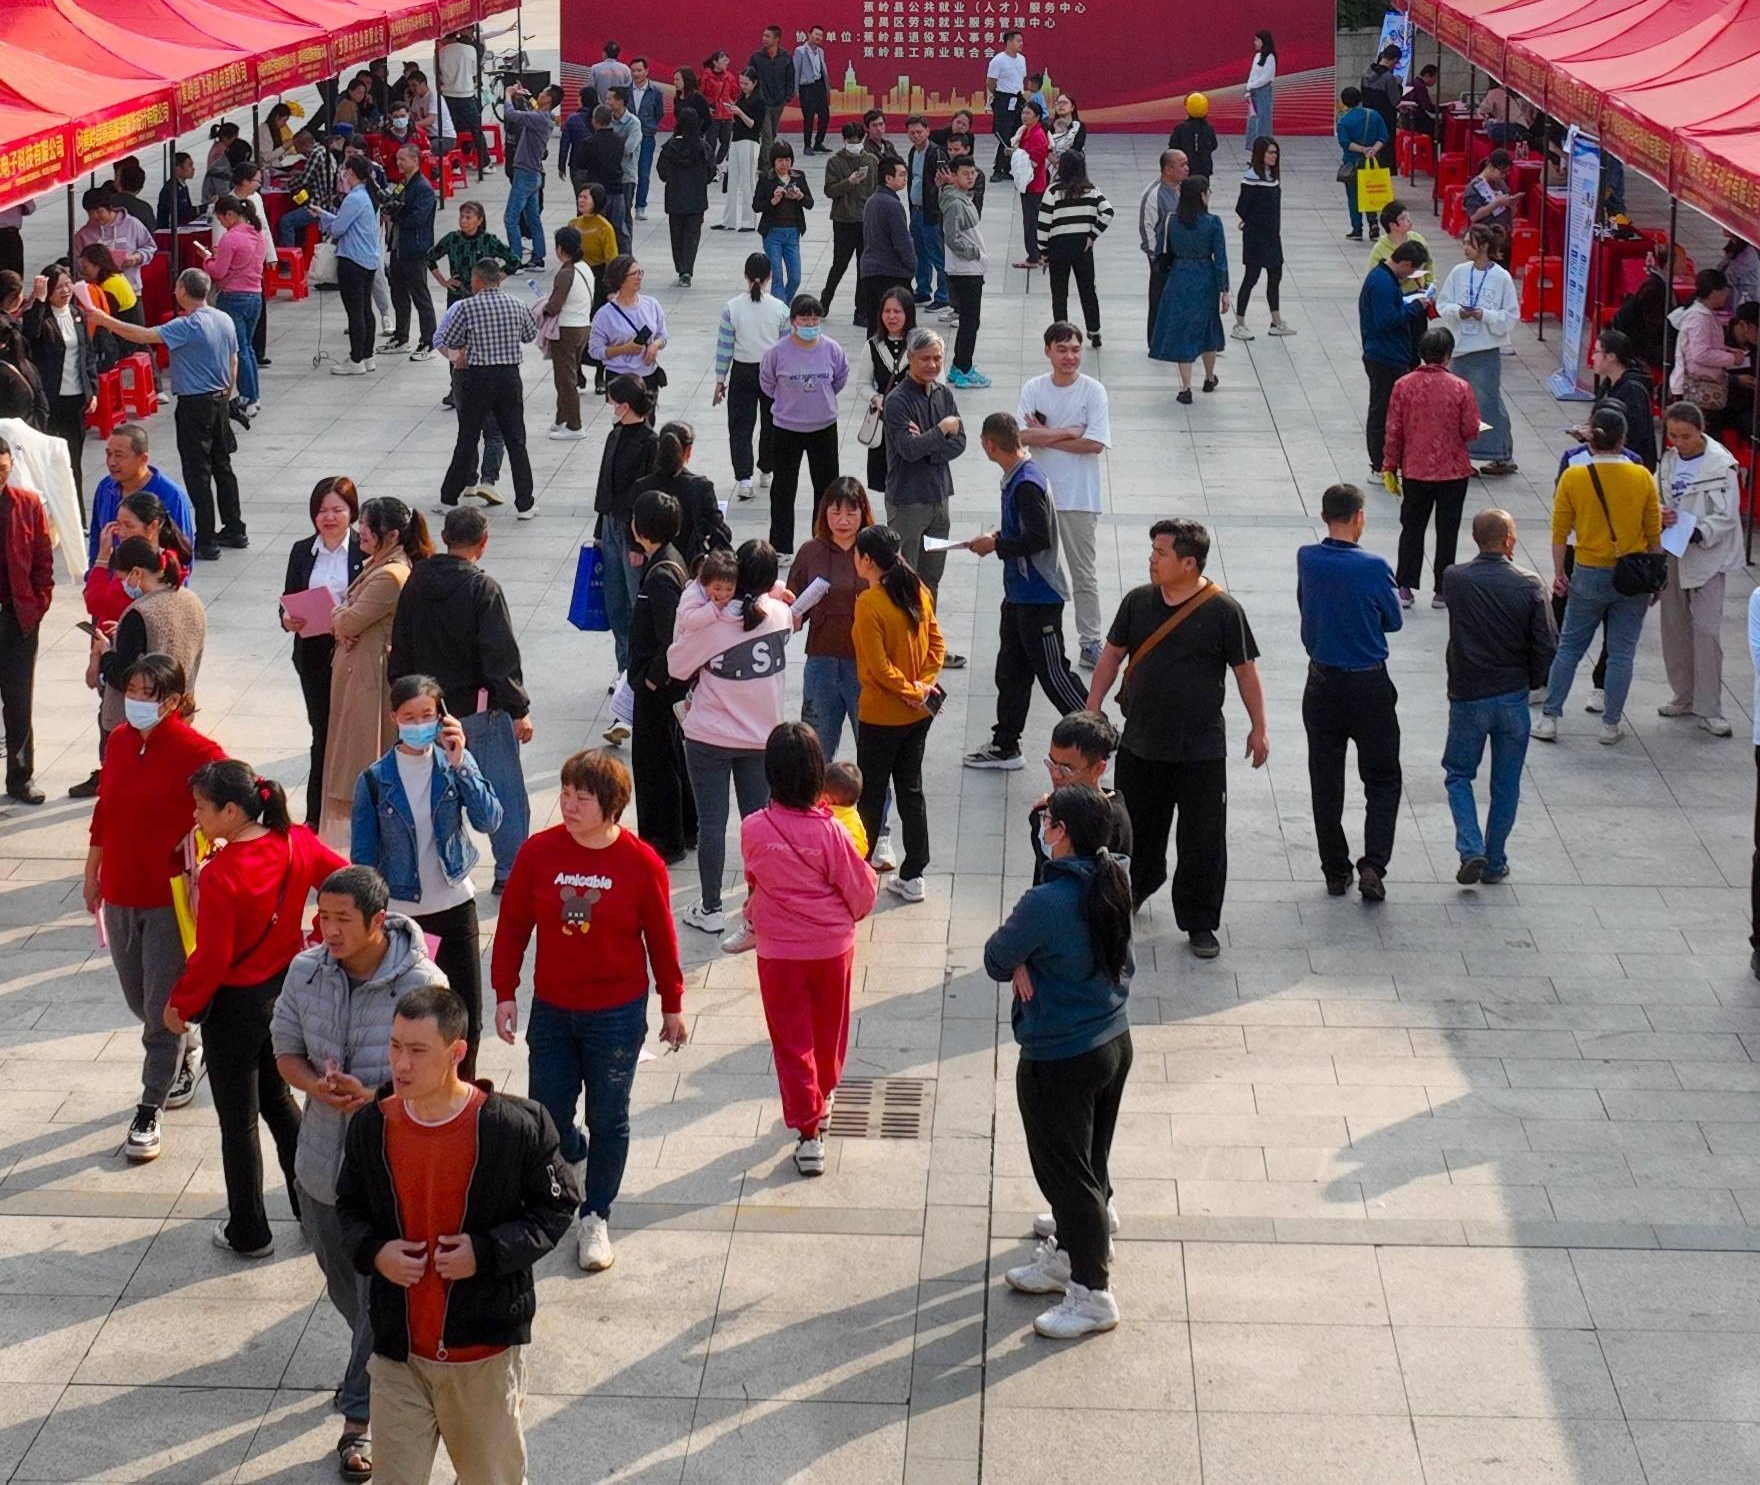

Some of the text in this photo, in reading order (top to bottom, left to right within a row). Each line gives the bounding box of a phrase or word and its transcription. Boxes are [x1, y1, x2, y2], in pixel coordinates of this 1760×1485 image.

[862, 1, 1087, 14] 蕉岭县公共就业（人才）服务中心
[862, 16, 1057, 29] 番禺区劳动就业服务管理中心
[862, 46, 996, 59] 蕉岭县工商业联合会
[553, 871, 613, 891] Amicable
